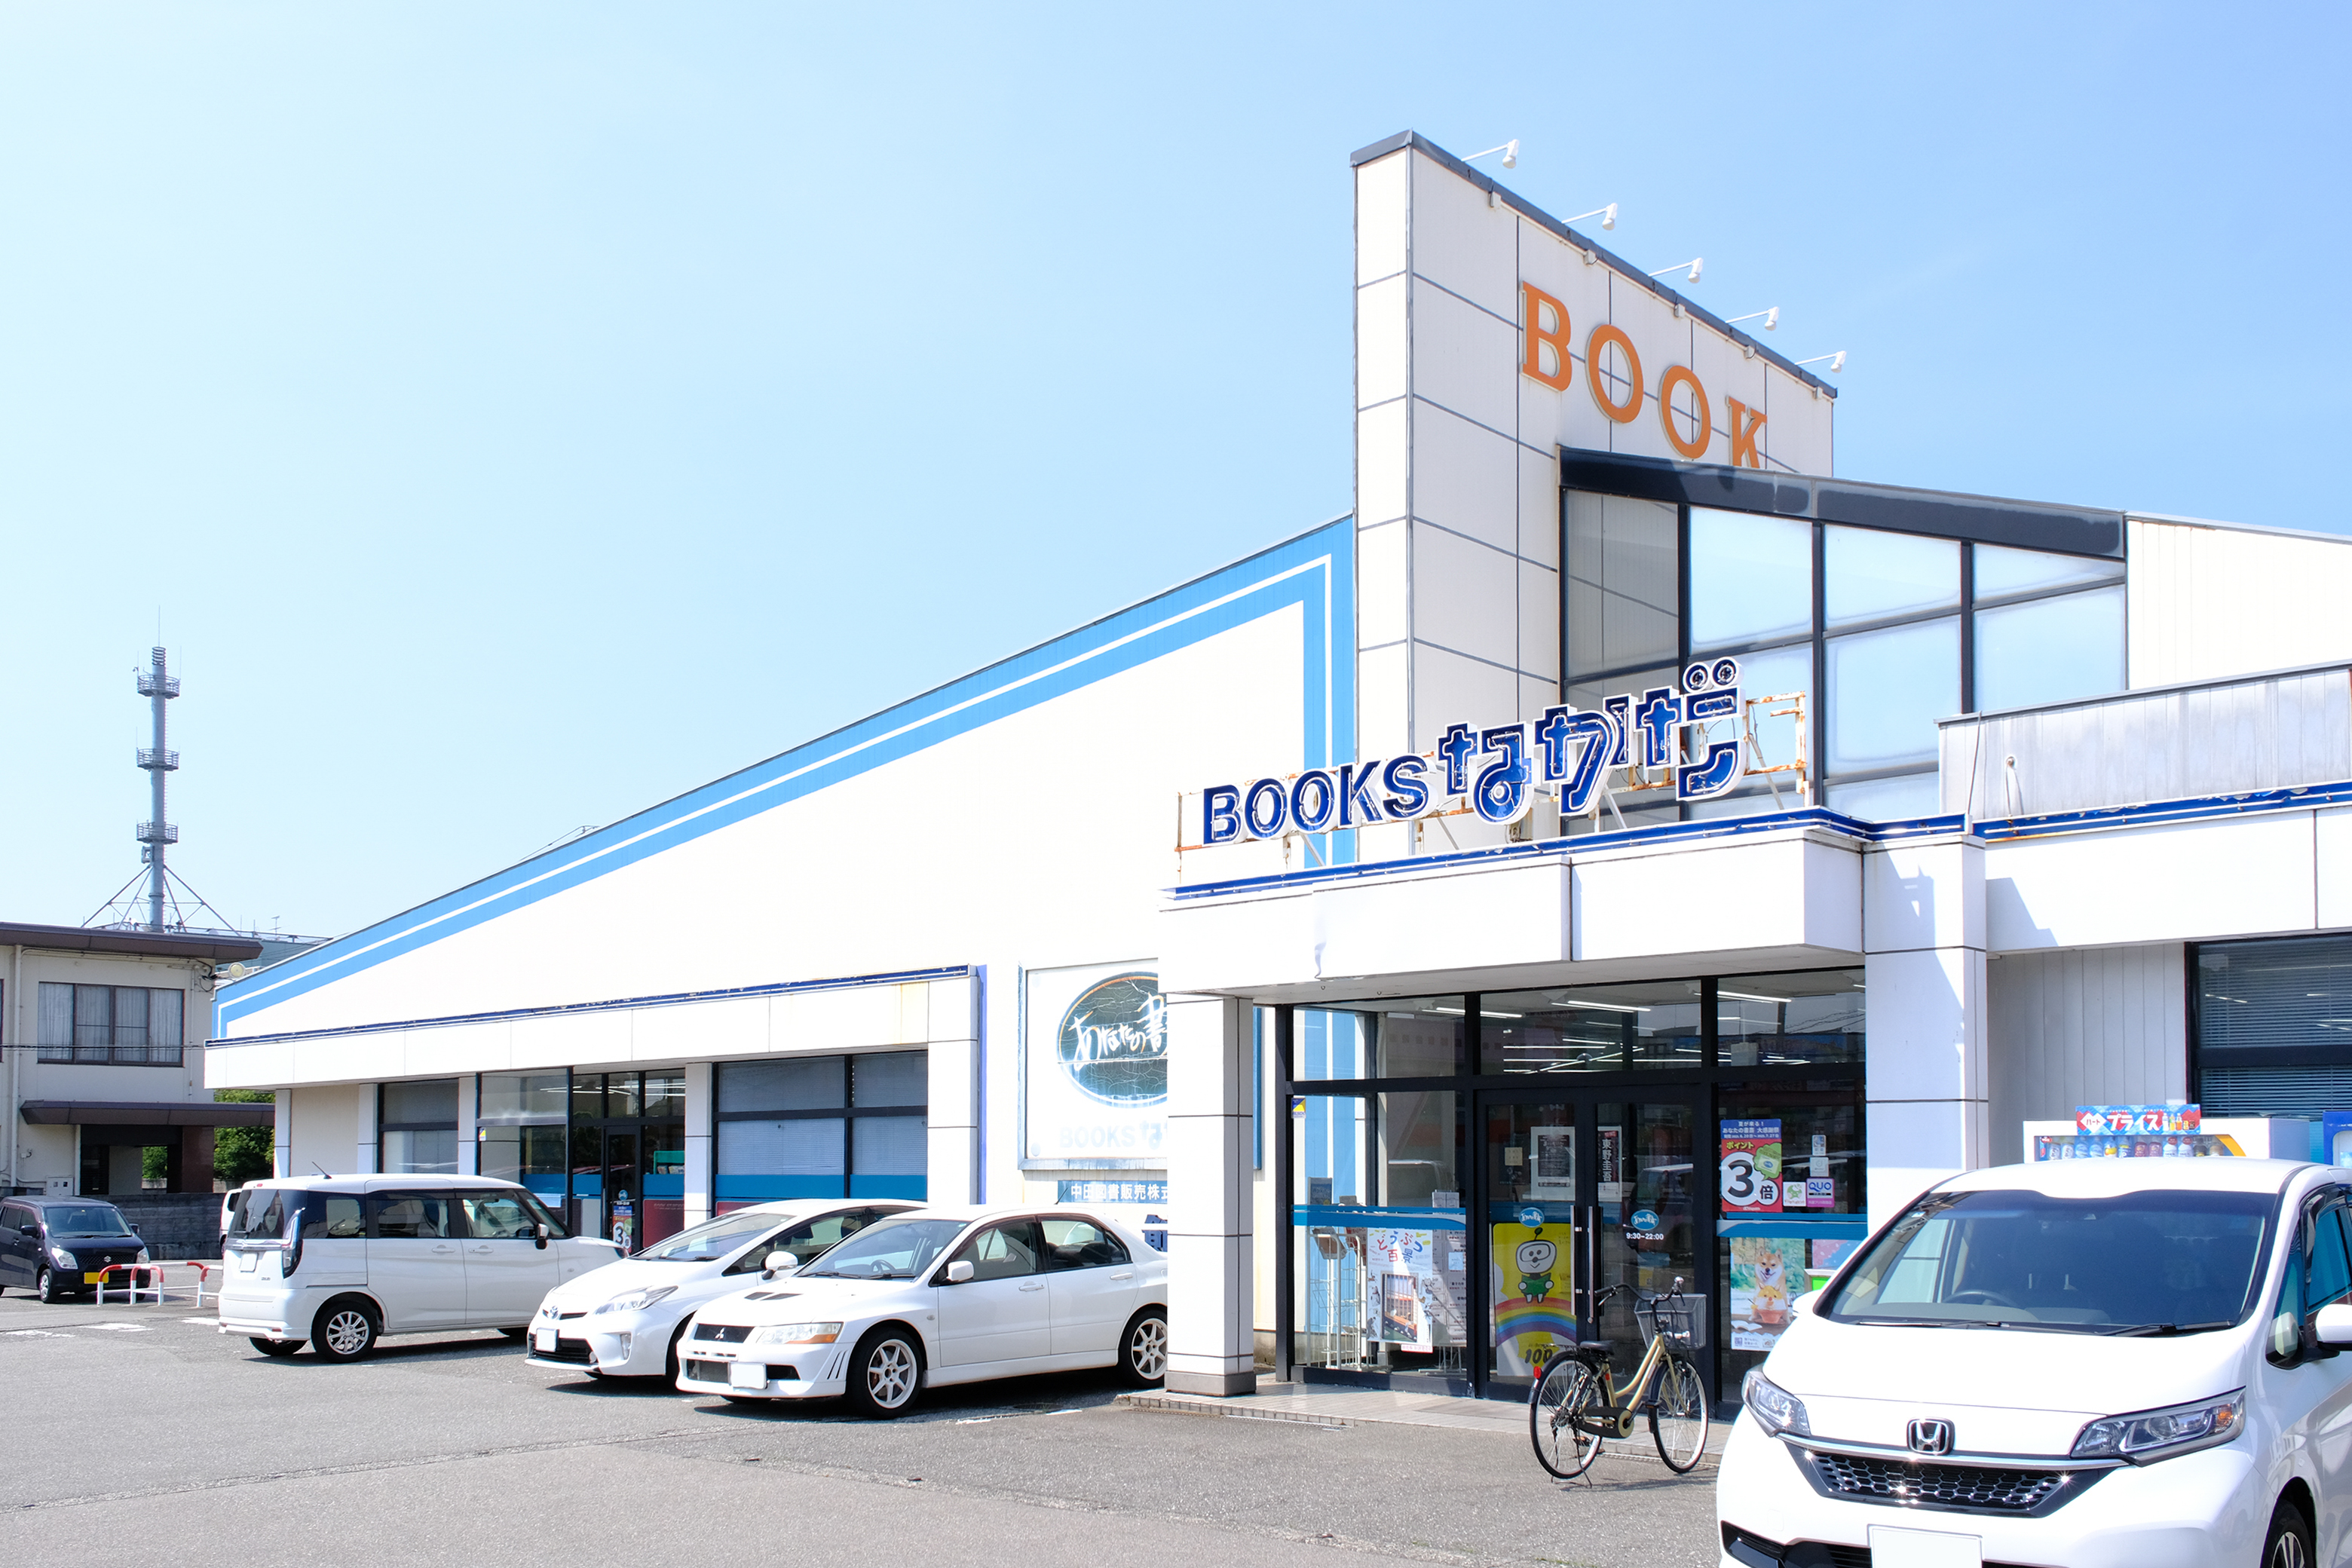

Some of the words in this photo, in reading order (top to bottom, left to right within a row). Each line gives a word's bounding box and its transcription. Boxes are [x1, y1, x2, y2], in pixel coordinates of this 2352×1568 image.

[1521, 280, 1768, 469] BOOK
[1203, 754, 1435, 845] BOOKS
[1438, 656, 1747, 825] なかだ
[1067, 991, 1168, 1071] あなたの書
[2106, 1113, 2161, 1132] プライス
[1059, 1125, 1136, 1149] BOOKS
[1139, 1119, 1168, 1150] な
[1726, 1141, 1754, 1150] ポイント
[1601, 1138, 1612, 1182] 東野圭吾
[1808, 1182, 1832, 1192] QUO
[1377, 1230, 1423, 1253] どうぶつ
[1387, 1248, 1413, 1264] 百景
[1524, 1348, 1553, 1364] 100
